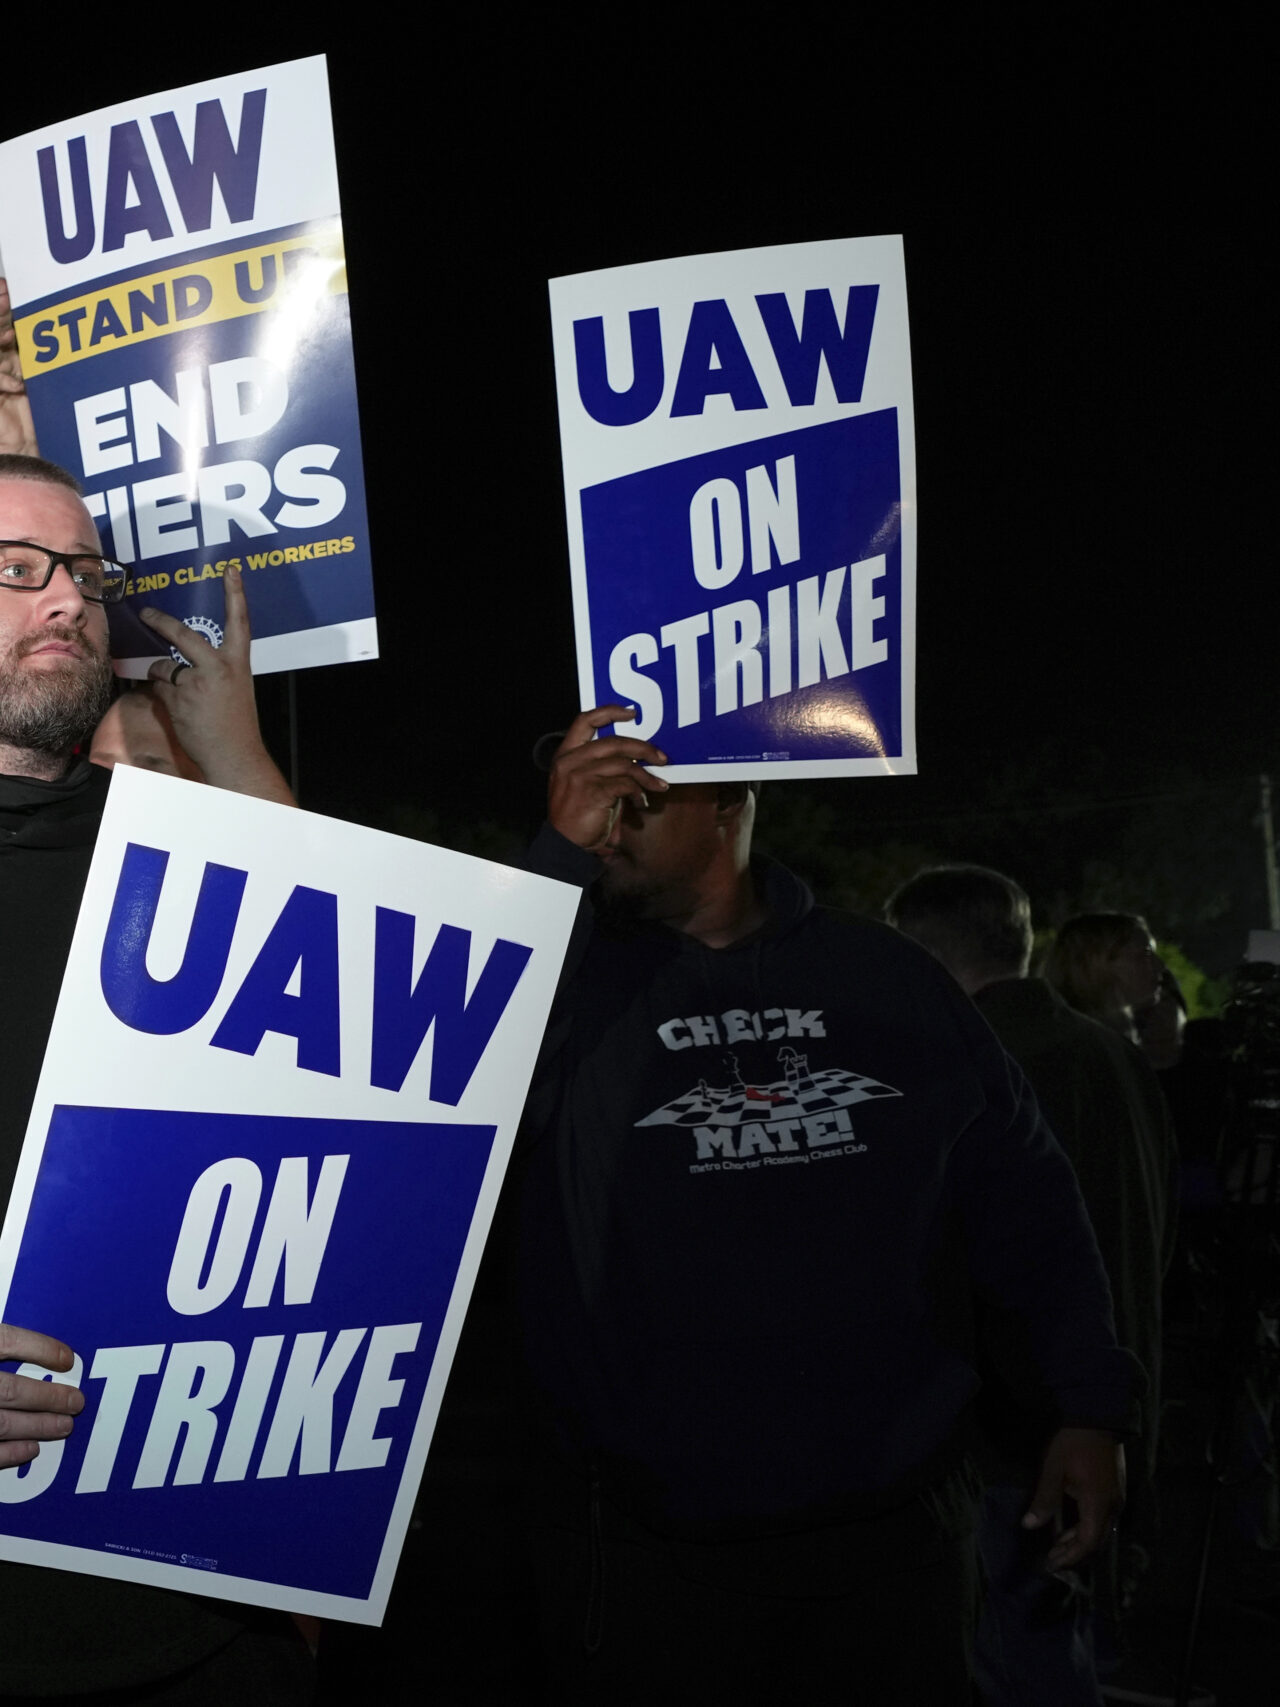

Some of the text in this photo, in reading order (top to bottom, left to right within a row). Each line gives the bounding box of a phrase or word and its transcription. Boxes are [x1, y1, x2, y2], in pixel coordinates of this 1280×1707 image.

[36, 88, 267, 265] UAW
[31, 274, 214, 365] STAND
[573, 284, 880, 427] UAW
[73, 356, 289, 477] END
[136, 572, 170, 594] 2ND
[246, 535, 356, 572] WORKERS
[689, 454, 801, 590] ON
[608, 553, 888, 741] STRIKE
[99, 842, 534, 1107] UAW
[657, 1008, 826, 1051] CHECK
[693, 1109, 855, 1160] MATE!
[166, 1154, 350, 1316] ON
